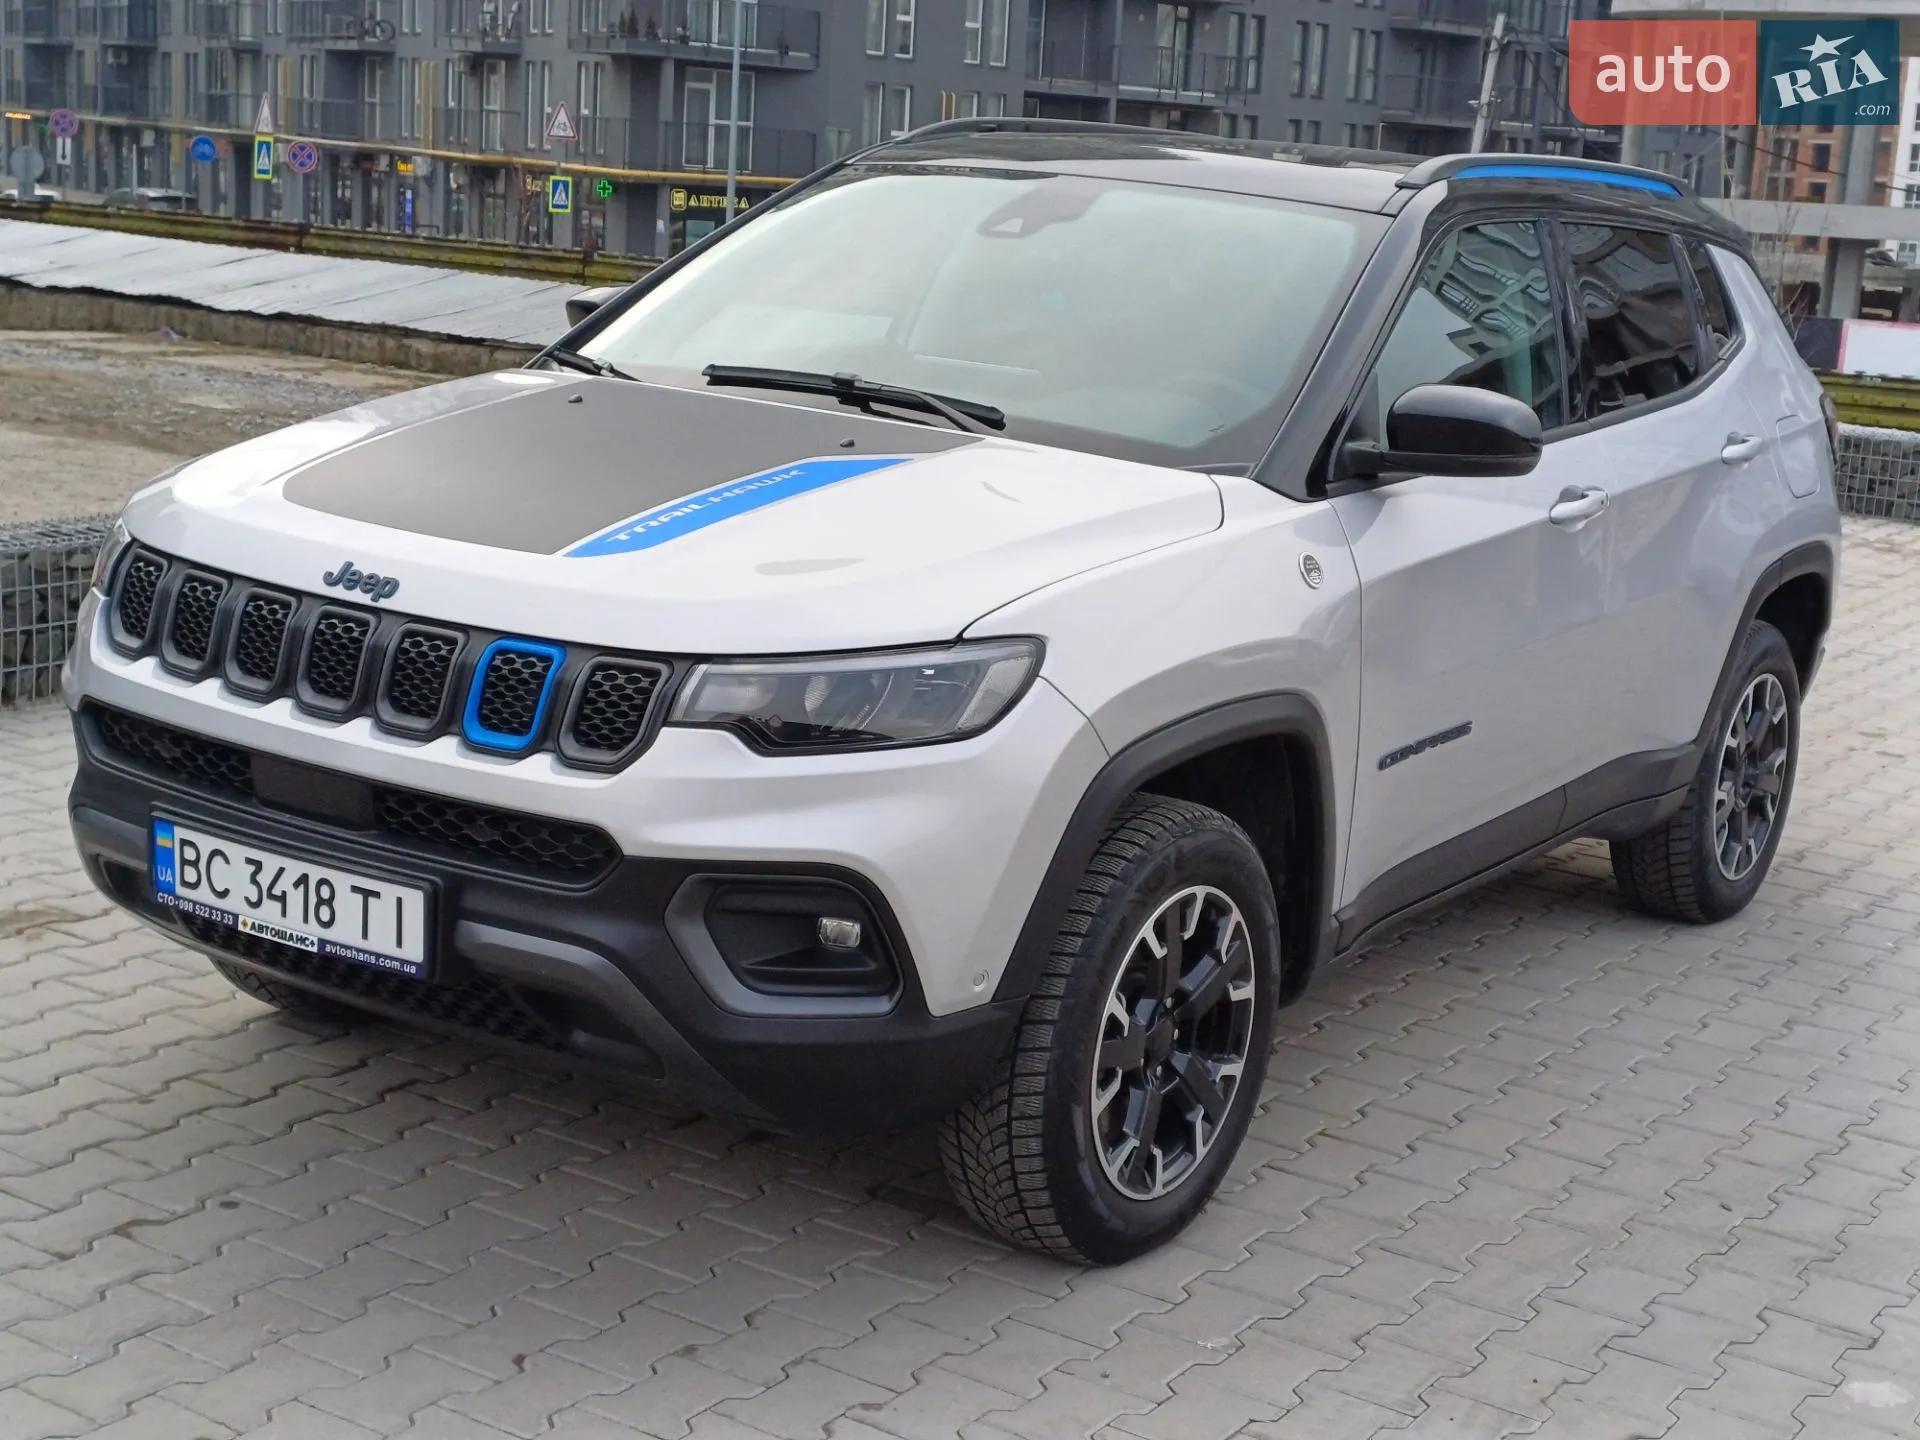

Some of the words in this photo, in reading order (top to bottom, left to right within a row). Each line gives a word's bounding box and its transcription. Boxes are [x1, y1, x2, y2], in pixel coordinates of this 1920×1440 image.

[323, 561, 400, 603] Jeep
[157, 866, 174, 885] UA
[178, 837, 231, 900] BC
[243, 856, 336, 930] 3418
[350, 884, 403, 950] TI
[195, 906, 210, 918] 522
[211, 910, 222, 922] 33
[223, 913, 233, 925] 33
[325, 943, 417, 974] avtoshans.com.ua
